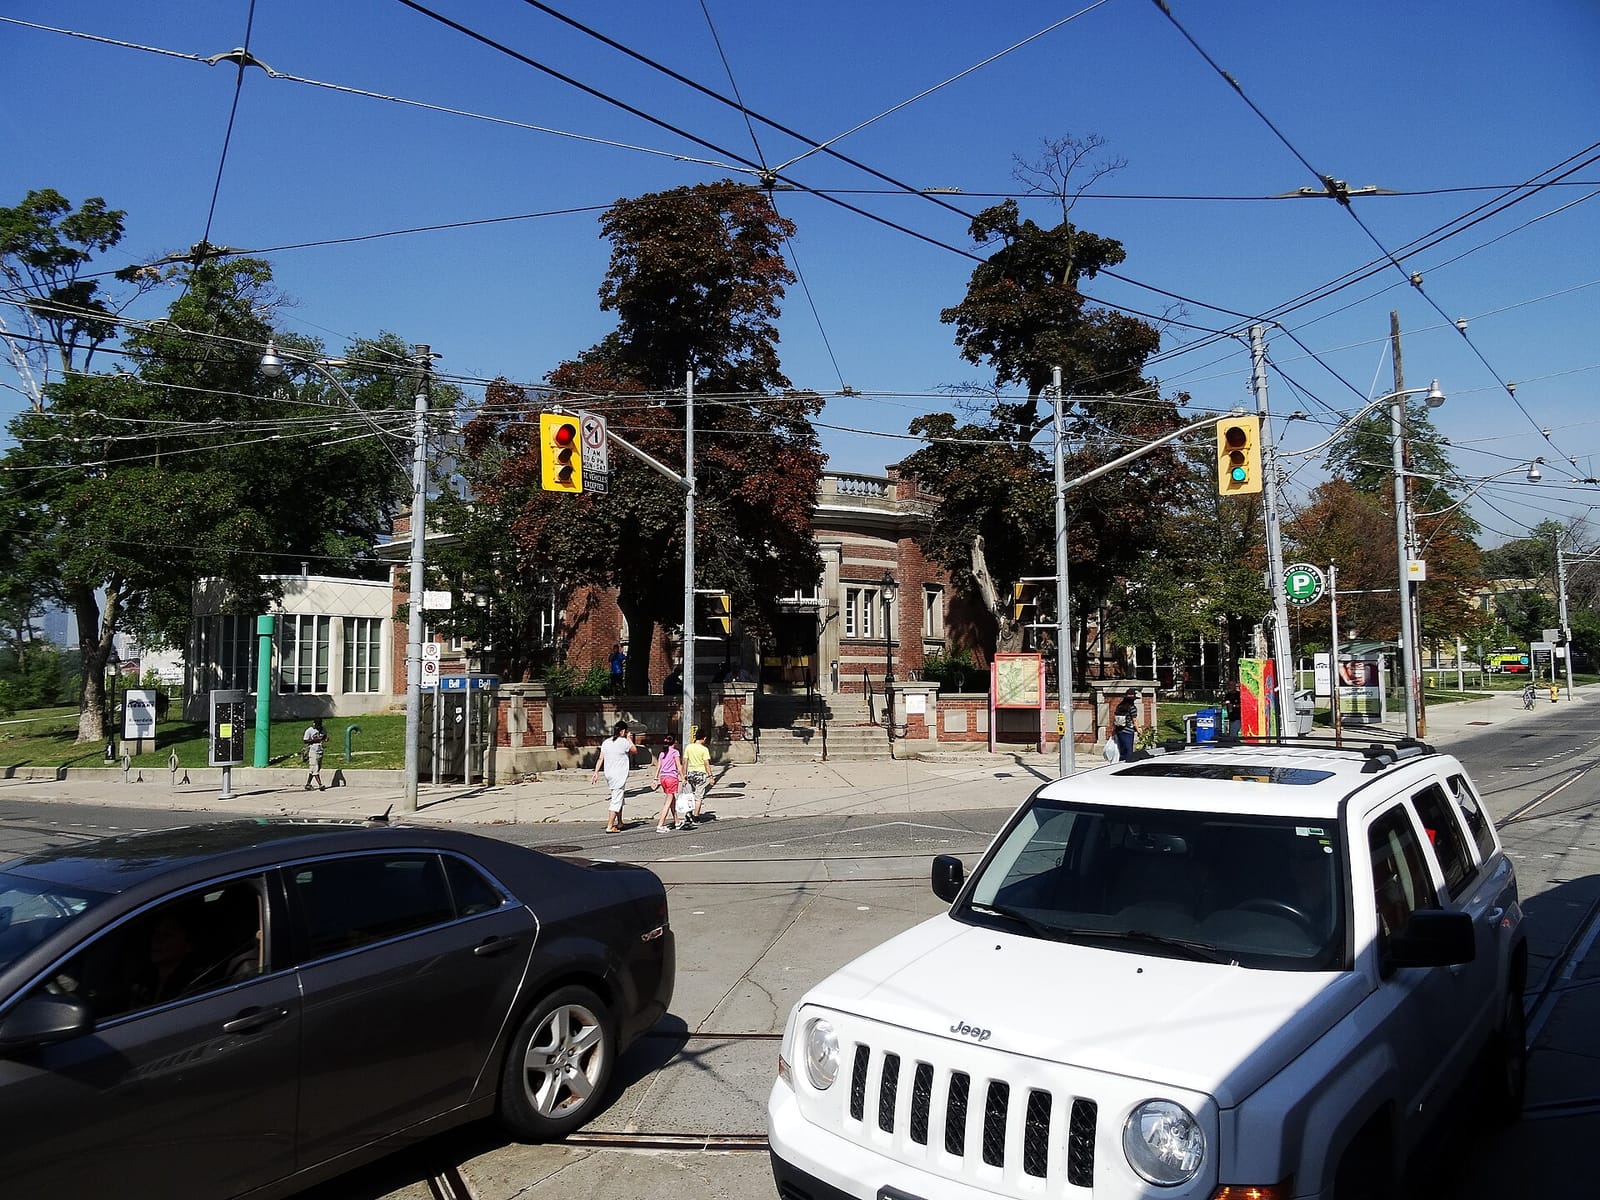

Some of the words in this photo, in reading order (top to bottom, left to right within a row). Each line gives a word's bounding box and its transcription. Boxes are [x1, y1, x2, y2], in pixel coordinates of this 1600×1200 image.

[586, 446, 591, 454] 7
[1292, 574, 1311, 592] P
[448, 678, 460, 688] Bell
[478, 678, 491, 688] Bell
[949, 1020, 992, 1042] Jeep
